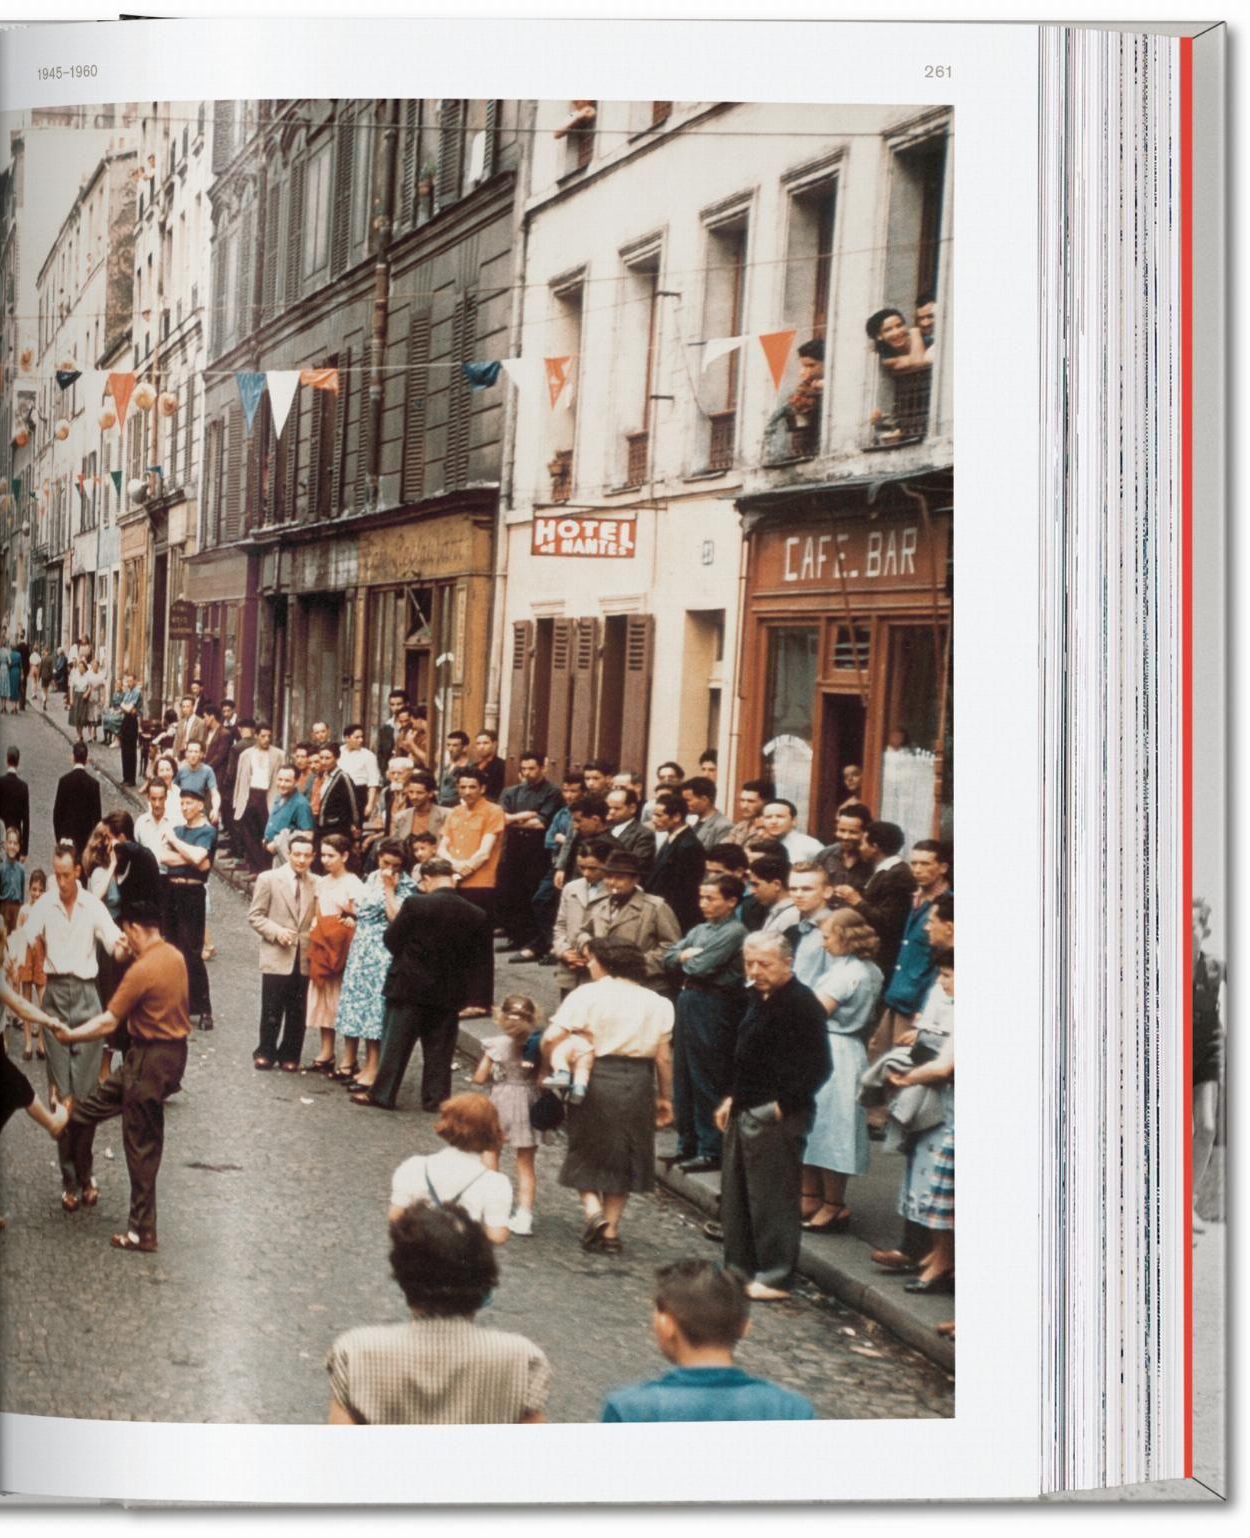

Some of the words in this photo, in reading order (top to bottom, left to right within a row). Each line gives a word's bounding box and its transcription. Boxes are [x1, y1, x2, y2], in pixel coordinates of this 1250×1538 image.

[924, 64, 953, 79] 261
[534, 518, 634, 549] HOTEL
[561, 538, 628, 556] NANTES
[864, 527, 918, 578] BAR
